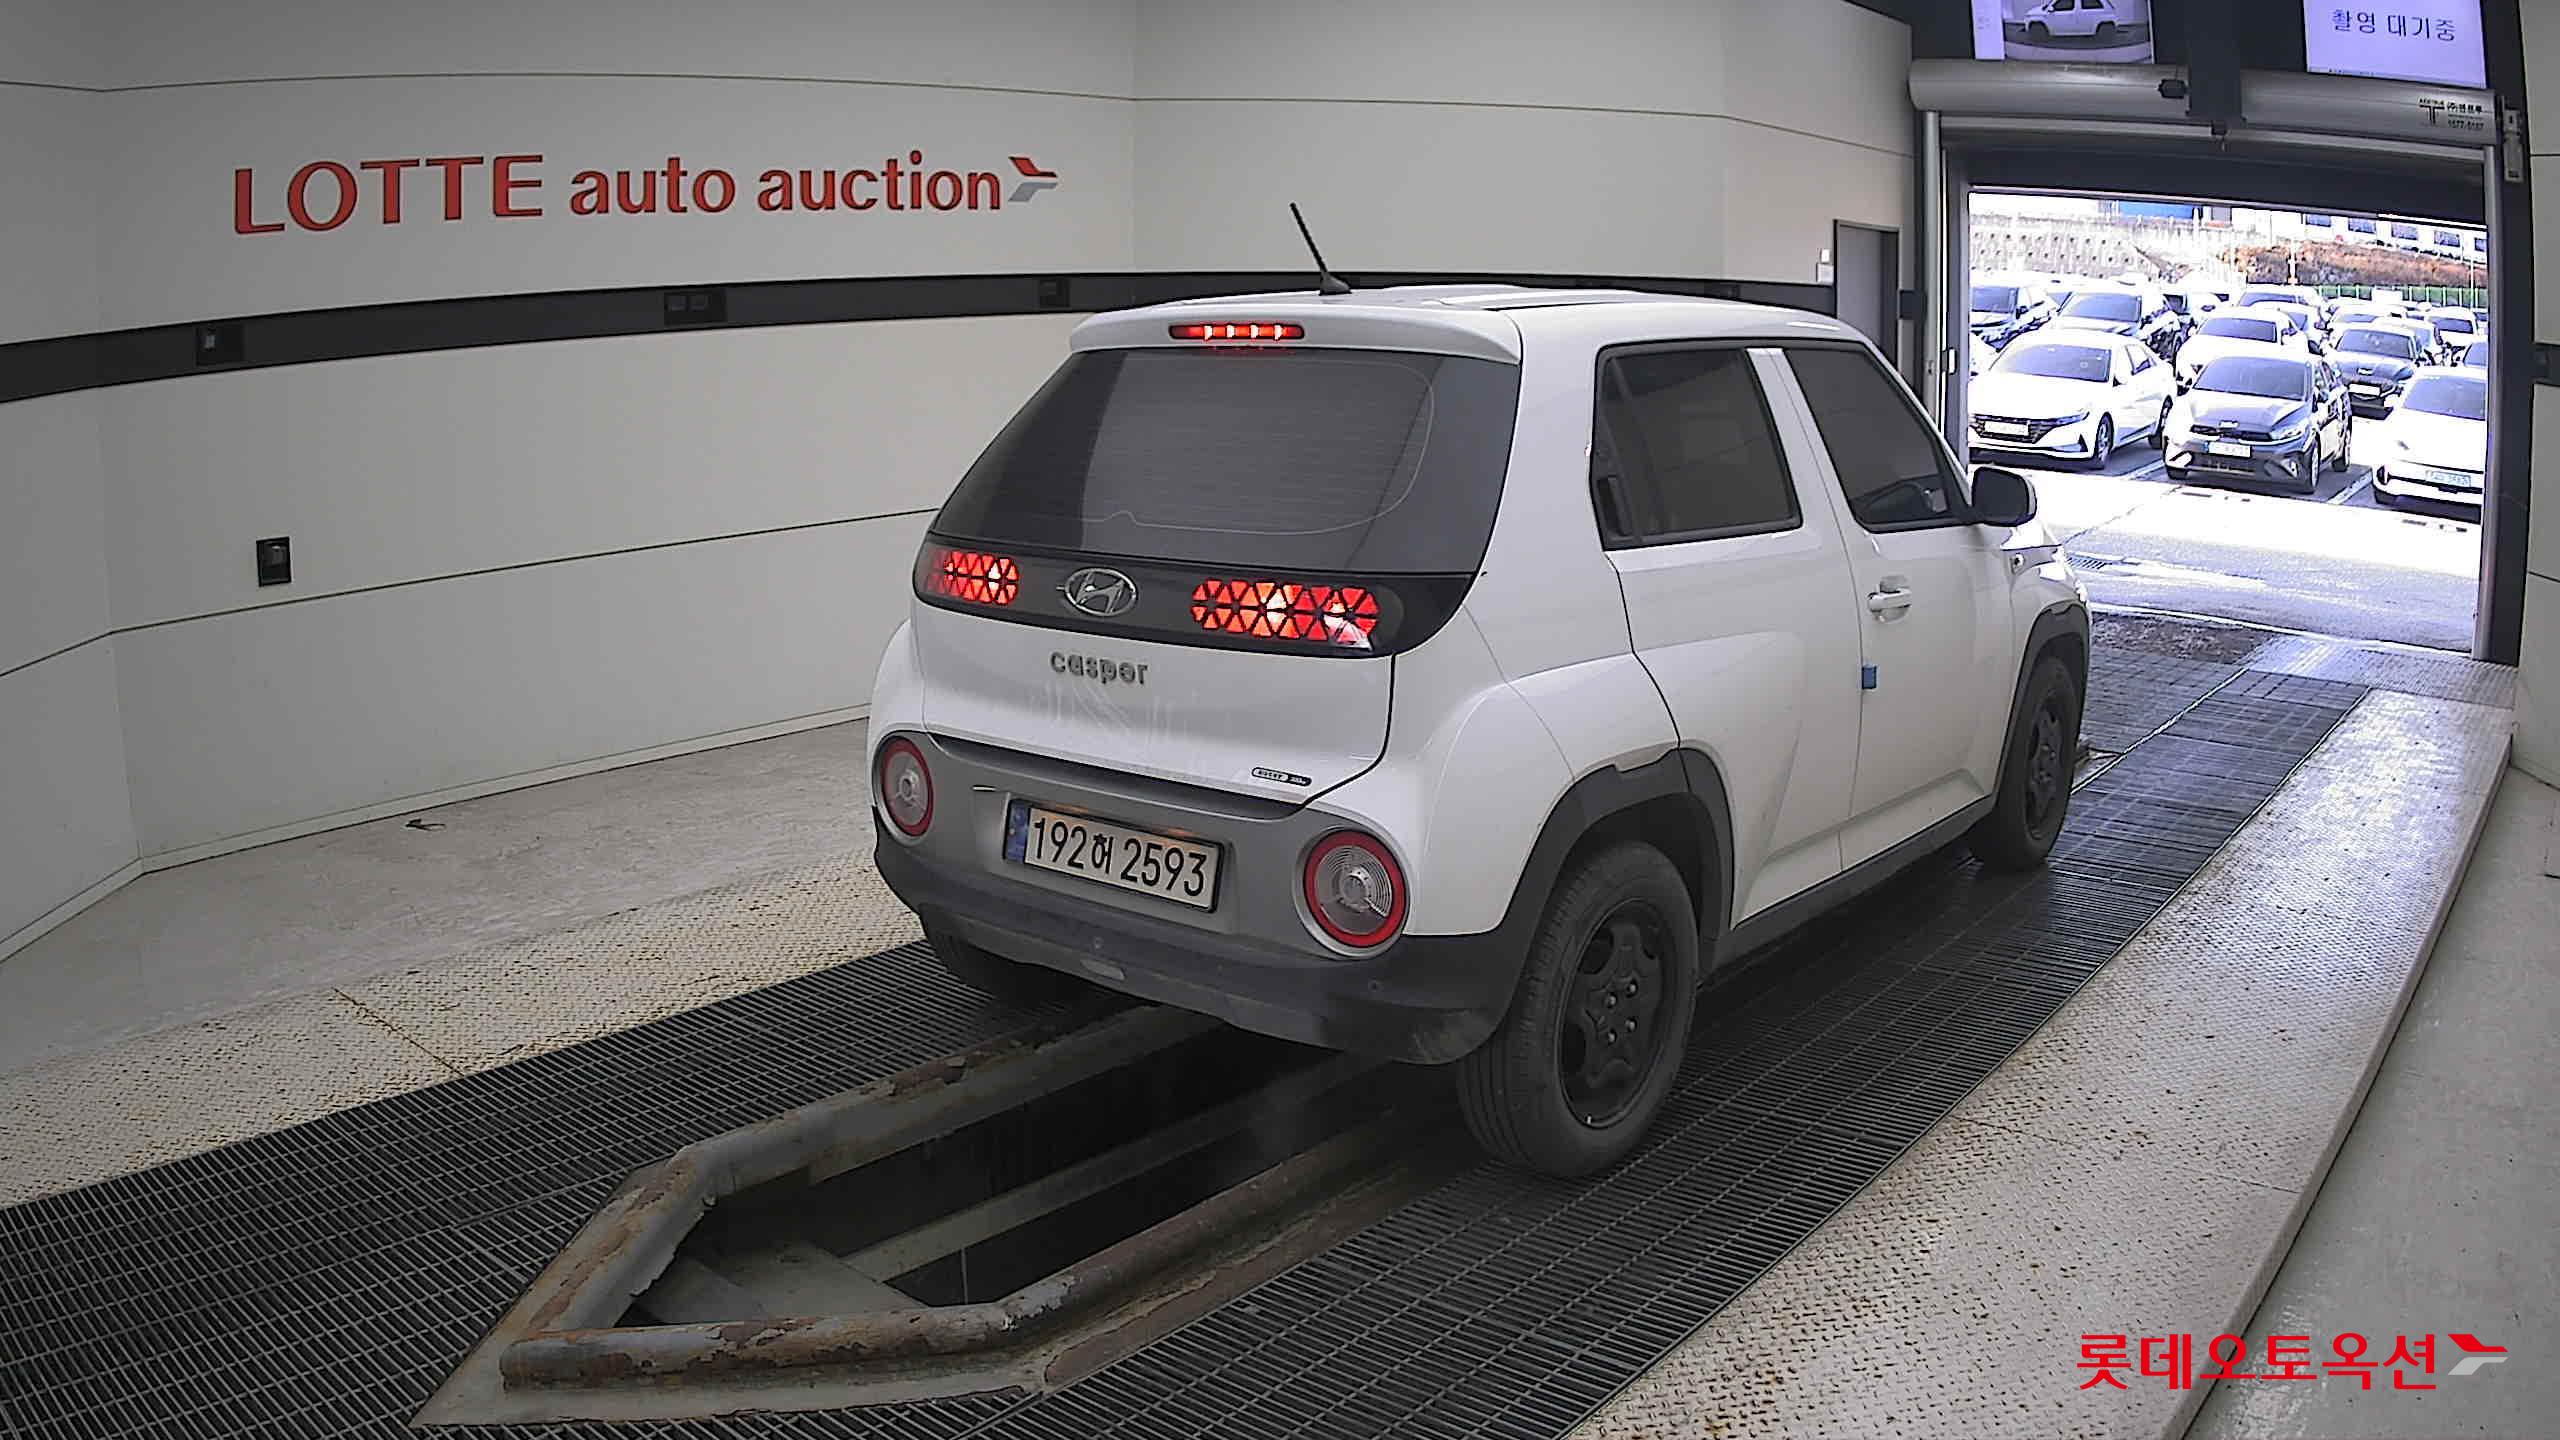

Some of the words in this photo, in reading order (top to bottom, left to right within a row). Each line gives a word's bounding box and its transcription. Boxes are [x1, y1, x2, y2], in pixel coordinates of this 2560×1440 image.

[2332, 9, 2376, 34] 촬영
[2387, 14, 2456, 42] 대기중
[234, 155, 543, 234] LOTTE
[569, 156, 736, 215] auto
[757, 150, 1001, 211] auction
[1050, 652, 1148, 684] casper
